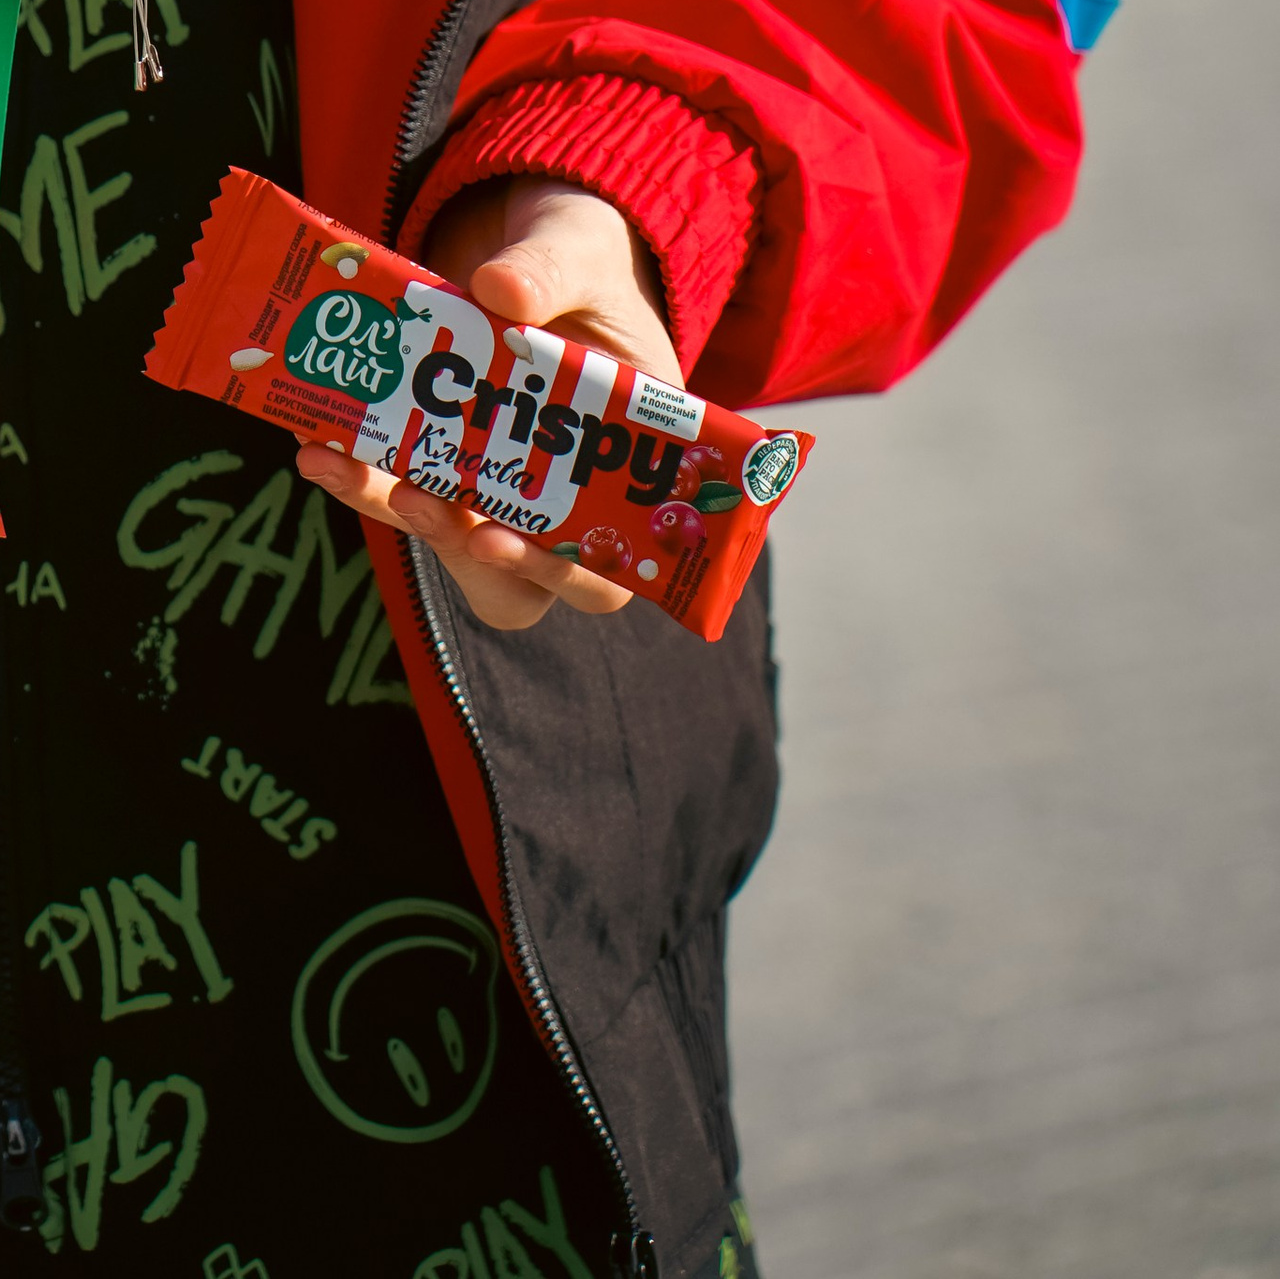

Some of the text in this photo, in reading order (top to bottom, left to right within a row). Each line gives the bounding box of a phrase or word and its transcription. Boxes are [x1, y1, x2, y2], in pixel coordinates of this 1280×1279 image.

[272, 223, 307, 291] Содержит сахара
[283, 247, 308, 296] природного
[249, 298, 276, 341] Подходит
[259, 309, 282, 346] веганам
[262, 403, 318, 432] ШАРИКАМИ
[271, 378, 380, 426] ФРУКТОВЫЙ БАТОНЧИК
[636, 406, 678, 427] перекус
[640, 394, 697, 421] и полезный
[643, 382, 685, 405] Вкусный
[273, 393, 337, 425] ХРУСТЯЩИМИ
[338, 416, 390, 445] РИСОВЫМИ
[410, 351, 686, 507] Crispy
[412, 422, 535, 492] Клюква
[181, 735, 338, 860] START
[26, 841, 234, 1022] PLAY
